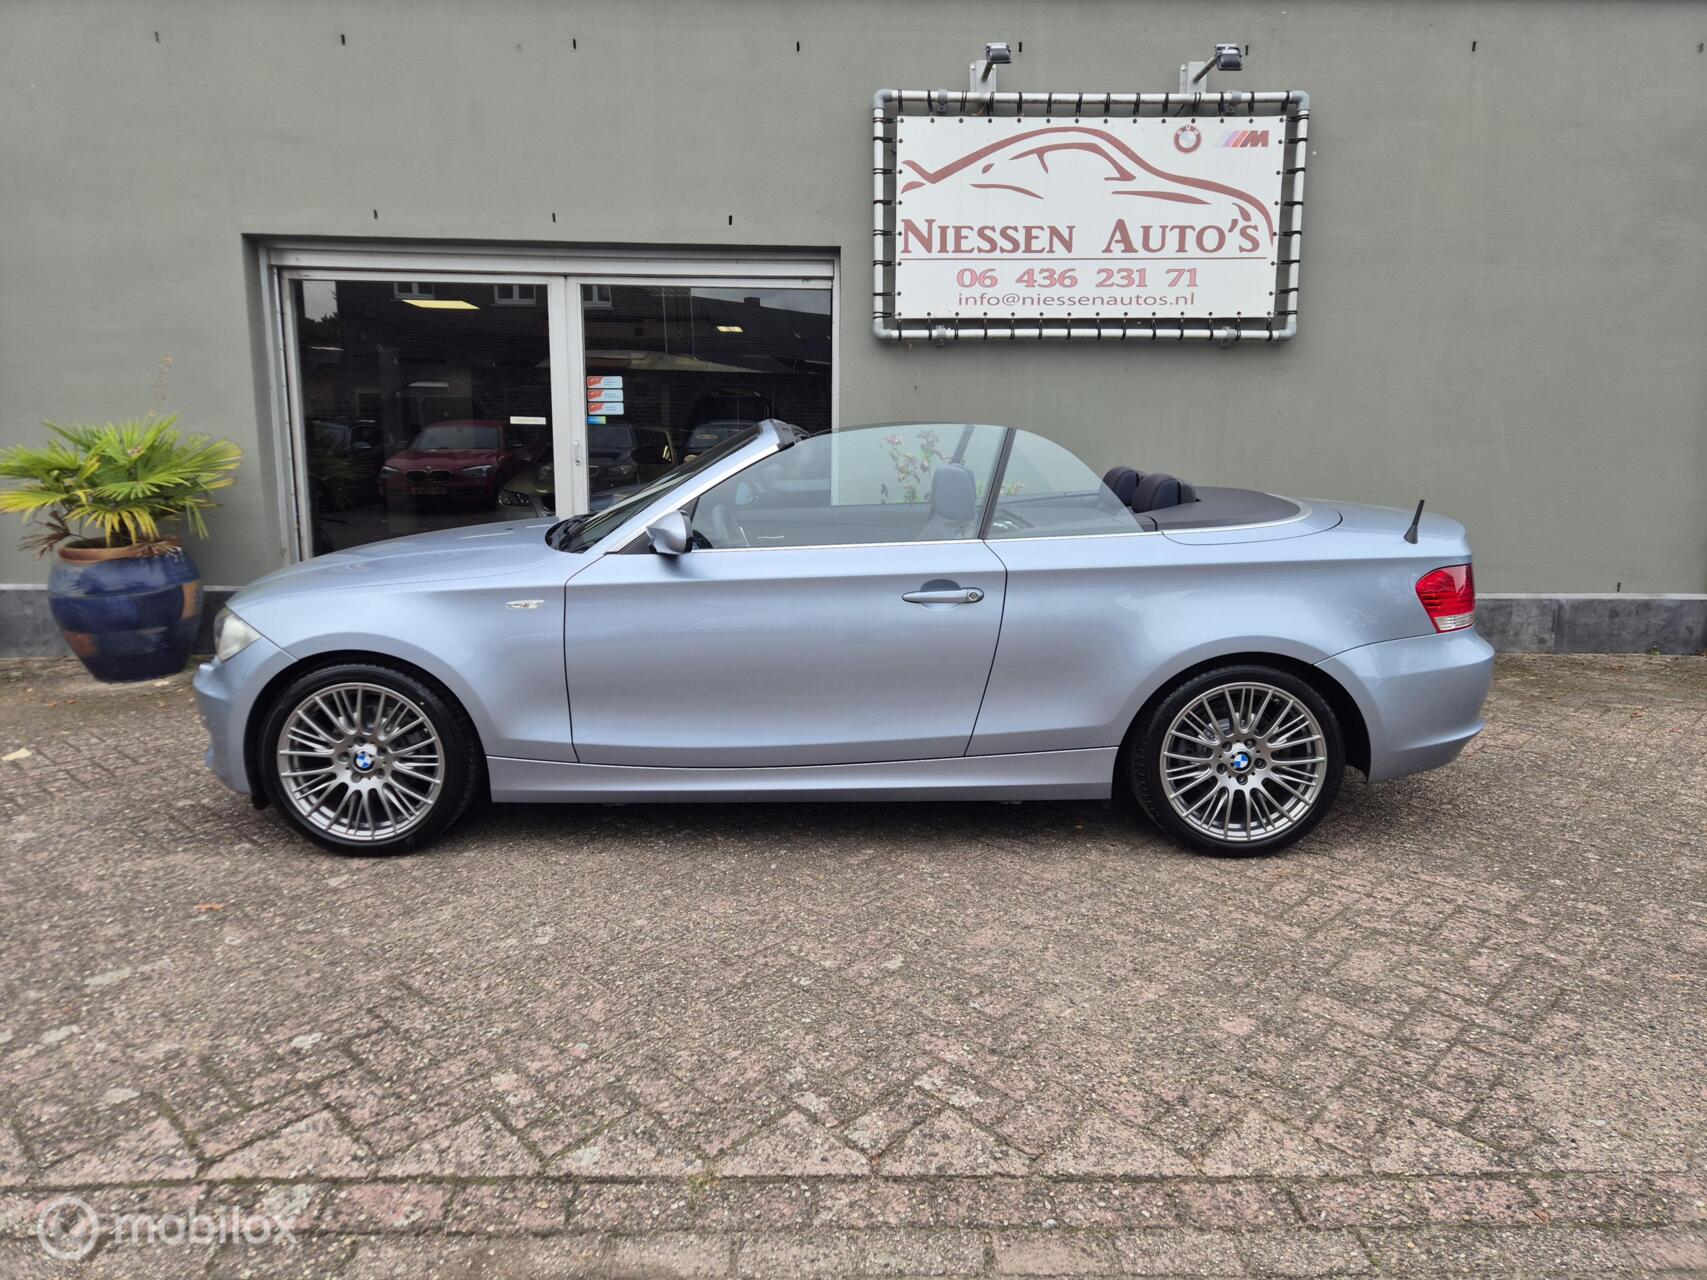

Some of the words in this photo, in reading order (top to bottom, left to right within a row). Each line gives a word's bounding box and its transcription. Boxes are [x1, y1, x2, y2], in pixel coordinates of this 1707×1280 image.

[900, 218, 1076, 254] NIESSEN
[956, 267, 998, 289] 06
[1015, 267, 1079, 289] 436
[1095, 267, 1148, 288] 231
[1165, 267, 1199, 288] 71
[957, 292, 1196, 307] info@niessenautos.nl
